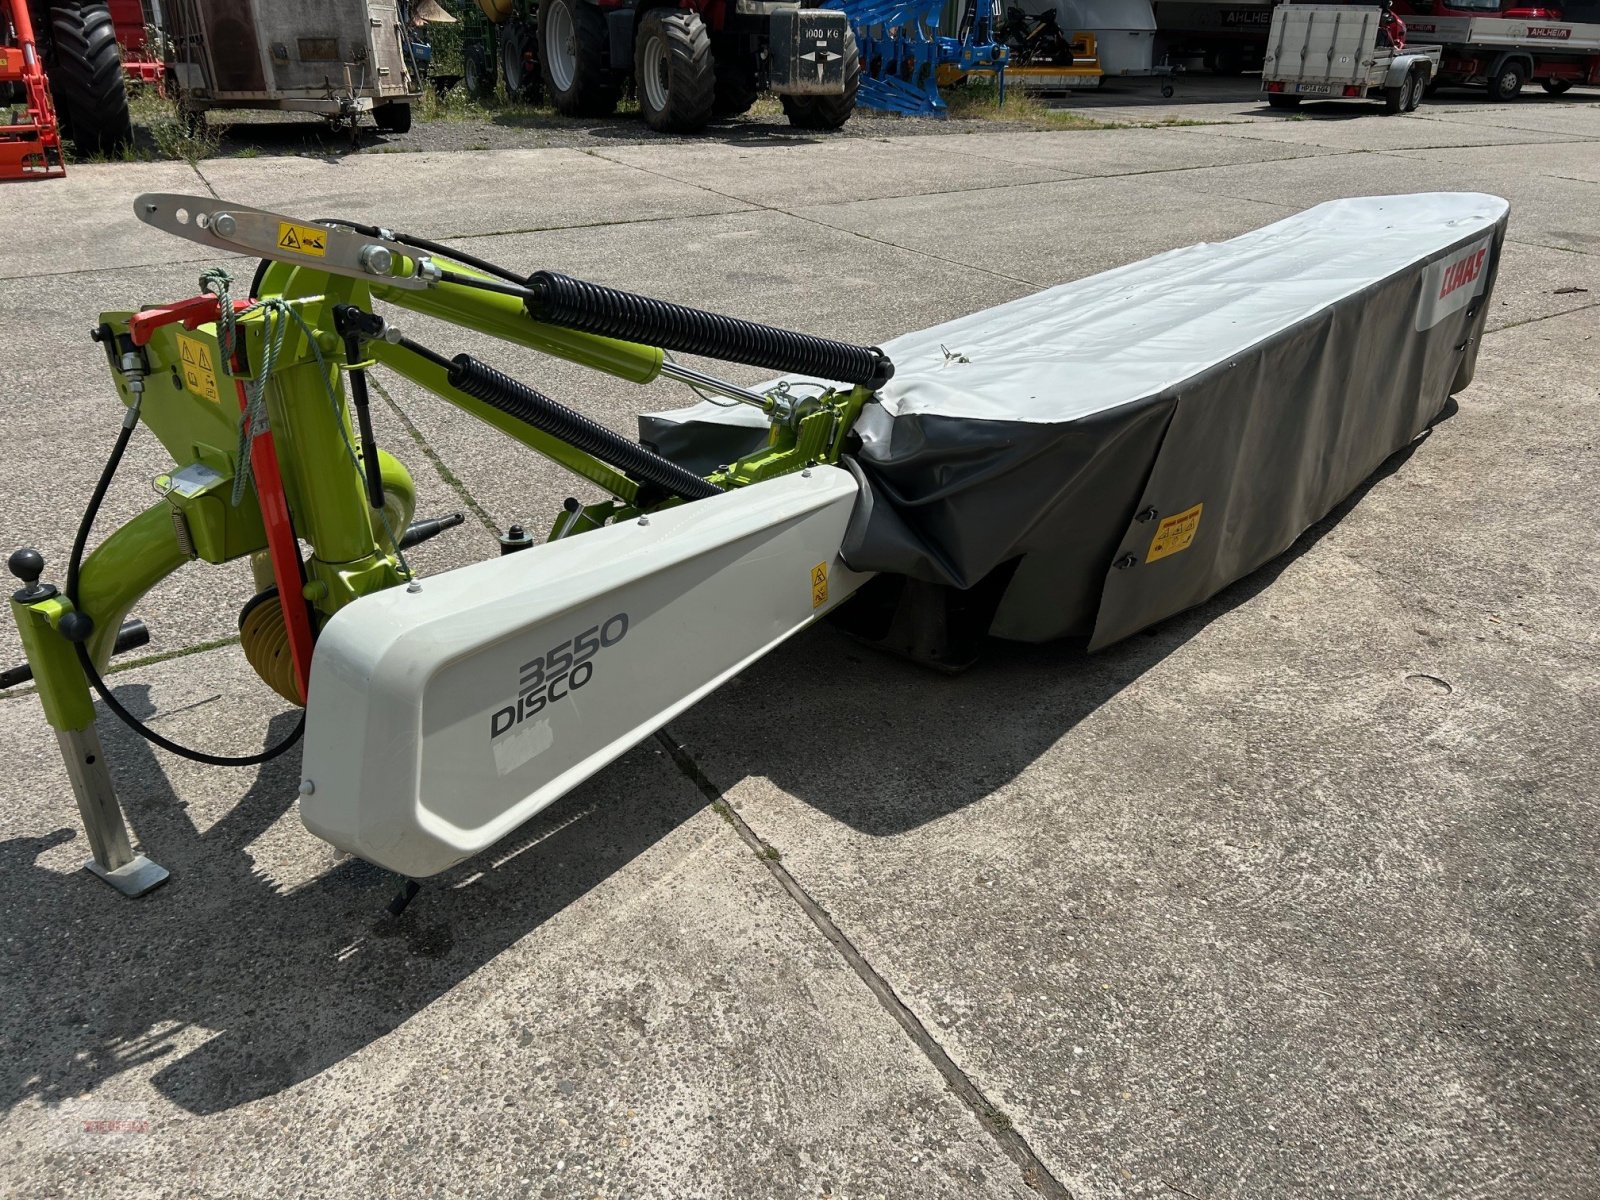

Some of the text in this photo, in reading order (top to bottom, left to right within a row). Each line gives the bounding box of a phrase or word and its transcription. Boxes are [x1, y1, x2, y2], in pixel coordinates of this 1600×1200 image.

[805, 29, 839, 38] 1000 KG
[1531, 28, 1567, 37] AHLHEIM
[1439, 248, 1486, 301] CLAAS
[519, 612, 629, 697] 3550
[490, 661, 593, 739] DISCO
